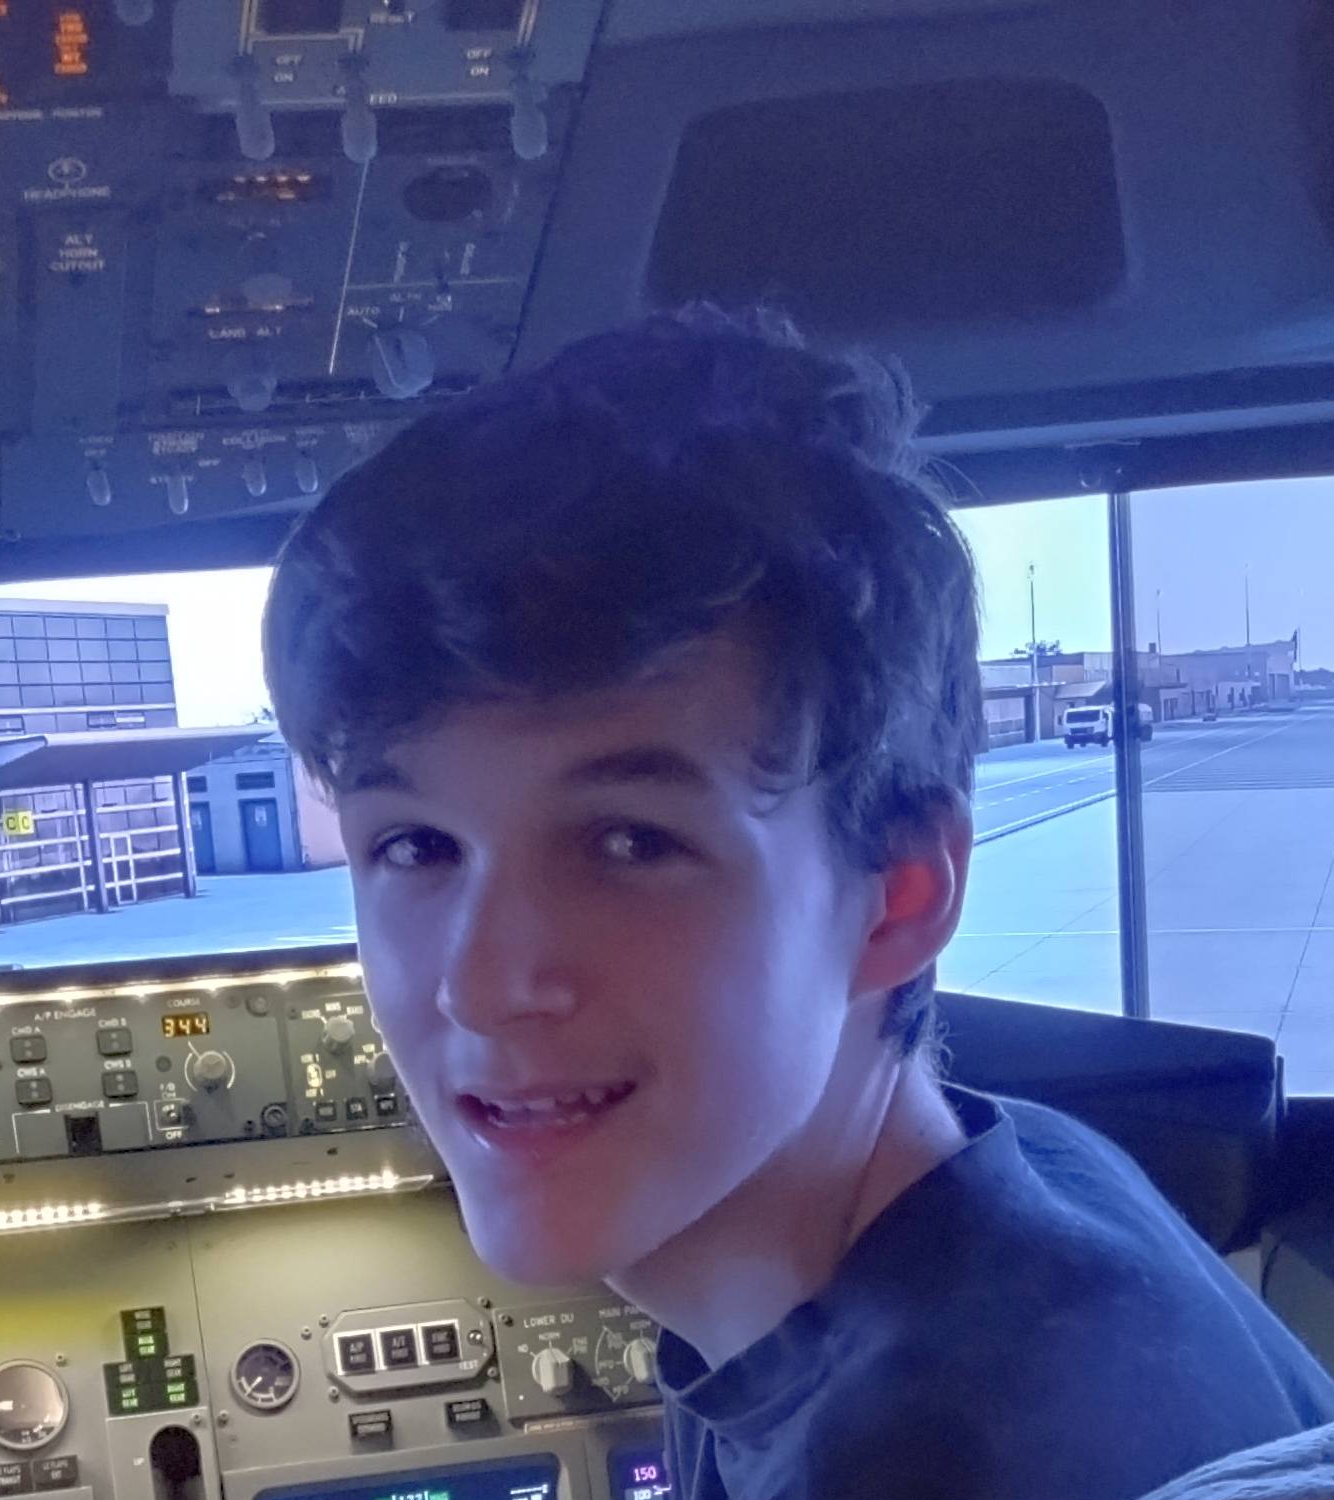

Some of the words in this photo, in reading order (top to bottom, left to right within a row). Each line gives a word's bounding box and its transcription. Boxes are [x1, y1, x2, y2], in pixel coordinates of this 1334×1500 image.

[24, 186, 110, 200] HEADPHONE
[35, 1011, 52, 1022] A/P
[54, 1009, 96, 1019] ENGAGE
[164, 1018, 207, 1037] 344
[166, 1131, 182, 1139] OFF
[523, 1315, 555, 1328] LOWER
[559, 1313, 574, 1324] DU
[634, 1467, 657, 1481] 150
